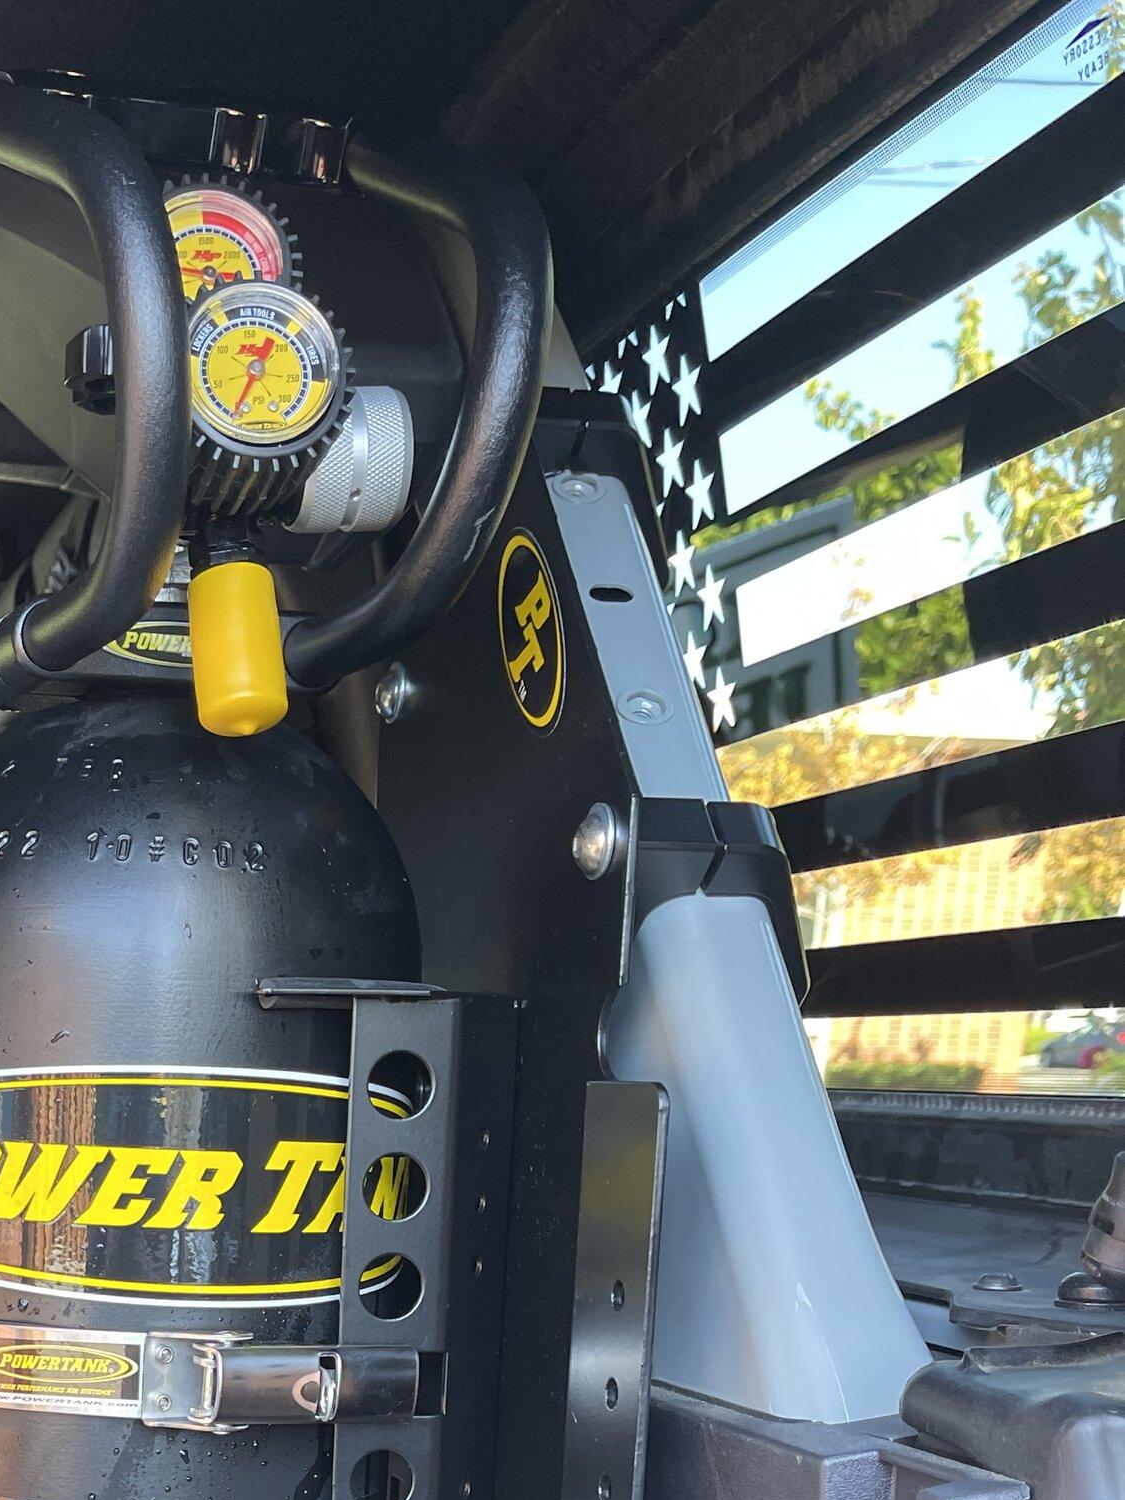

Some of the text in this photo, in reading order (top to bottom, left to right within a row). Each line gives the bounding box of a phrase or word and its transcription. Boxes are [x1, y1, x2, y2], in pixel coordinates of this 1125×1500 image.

[240, 308, 276, 320] AIR TOOLS
[191, 323, 214, 352] LOCKERS
[243, 329, 256, 339] 150
[275, 344, 289, 353] 200
[305, 344, 320, 366] TIRES
[286, 374, 300, 384] 250
[213, 380, 223, 389] 50
[253, 396, 265, 405] PSI
